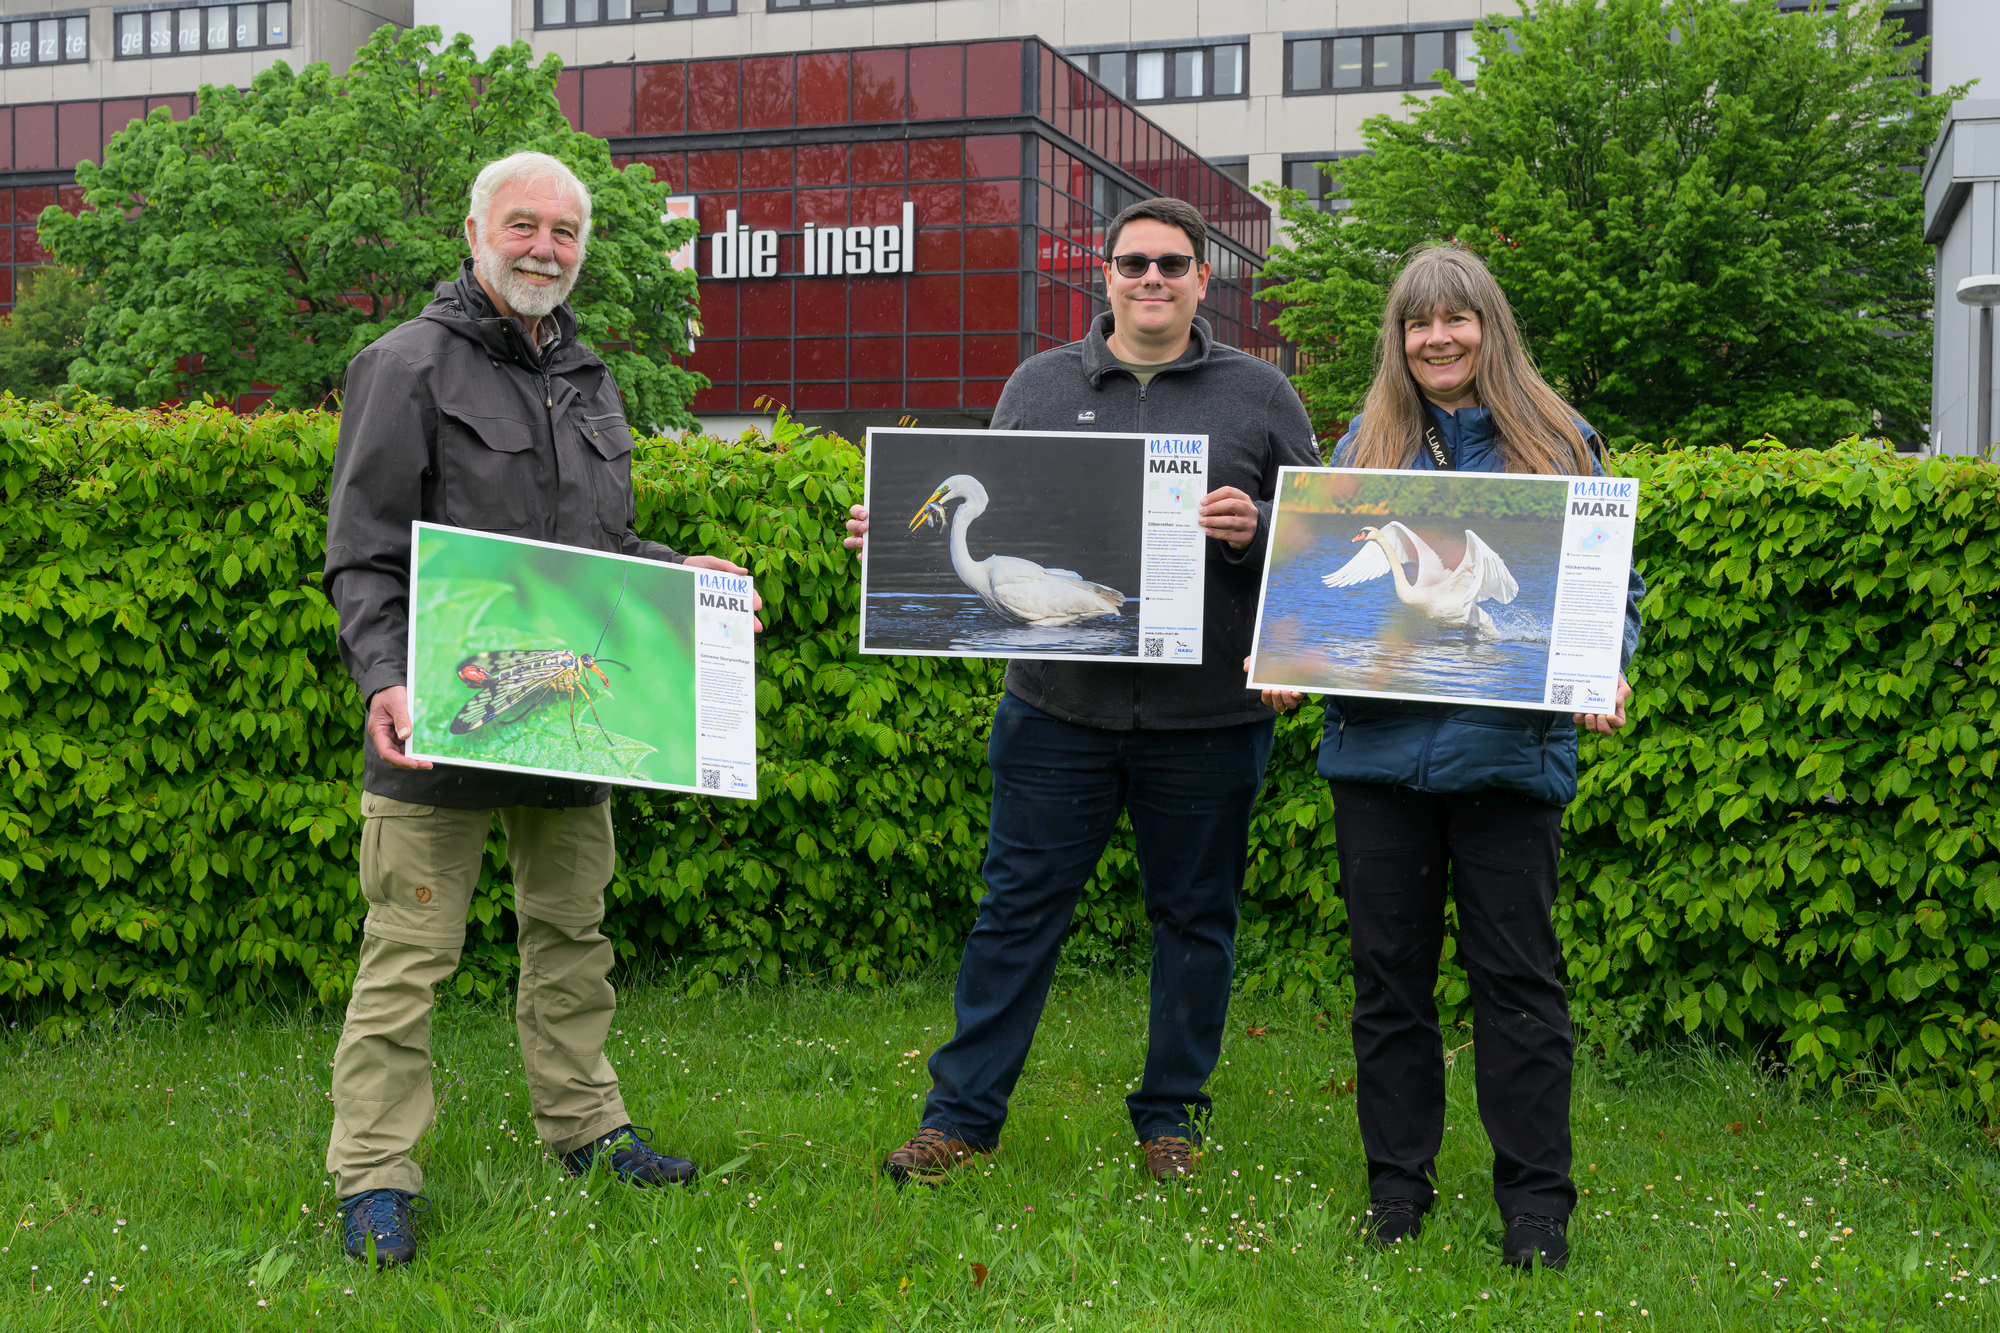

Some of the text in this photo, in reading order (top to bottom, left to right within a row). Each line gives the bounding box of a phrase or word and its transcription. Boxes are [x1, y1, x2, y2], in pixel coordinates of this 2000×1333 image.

[711, 201, 914, 279] die insel
[1150, 439, 1203, 455] NATUR
[1425, 426, 1448, 466] LUMIX
[1149, 459, 1202, 474] MARL
[1574, 481, 1632, 498] NATUR
[1571, 501, 1630, 518] MARL
[700, 574, 748, 593] NATUR
[700, 592, 749, 613] MARL
